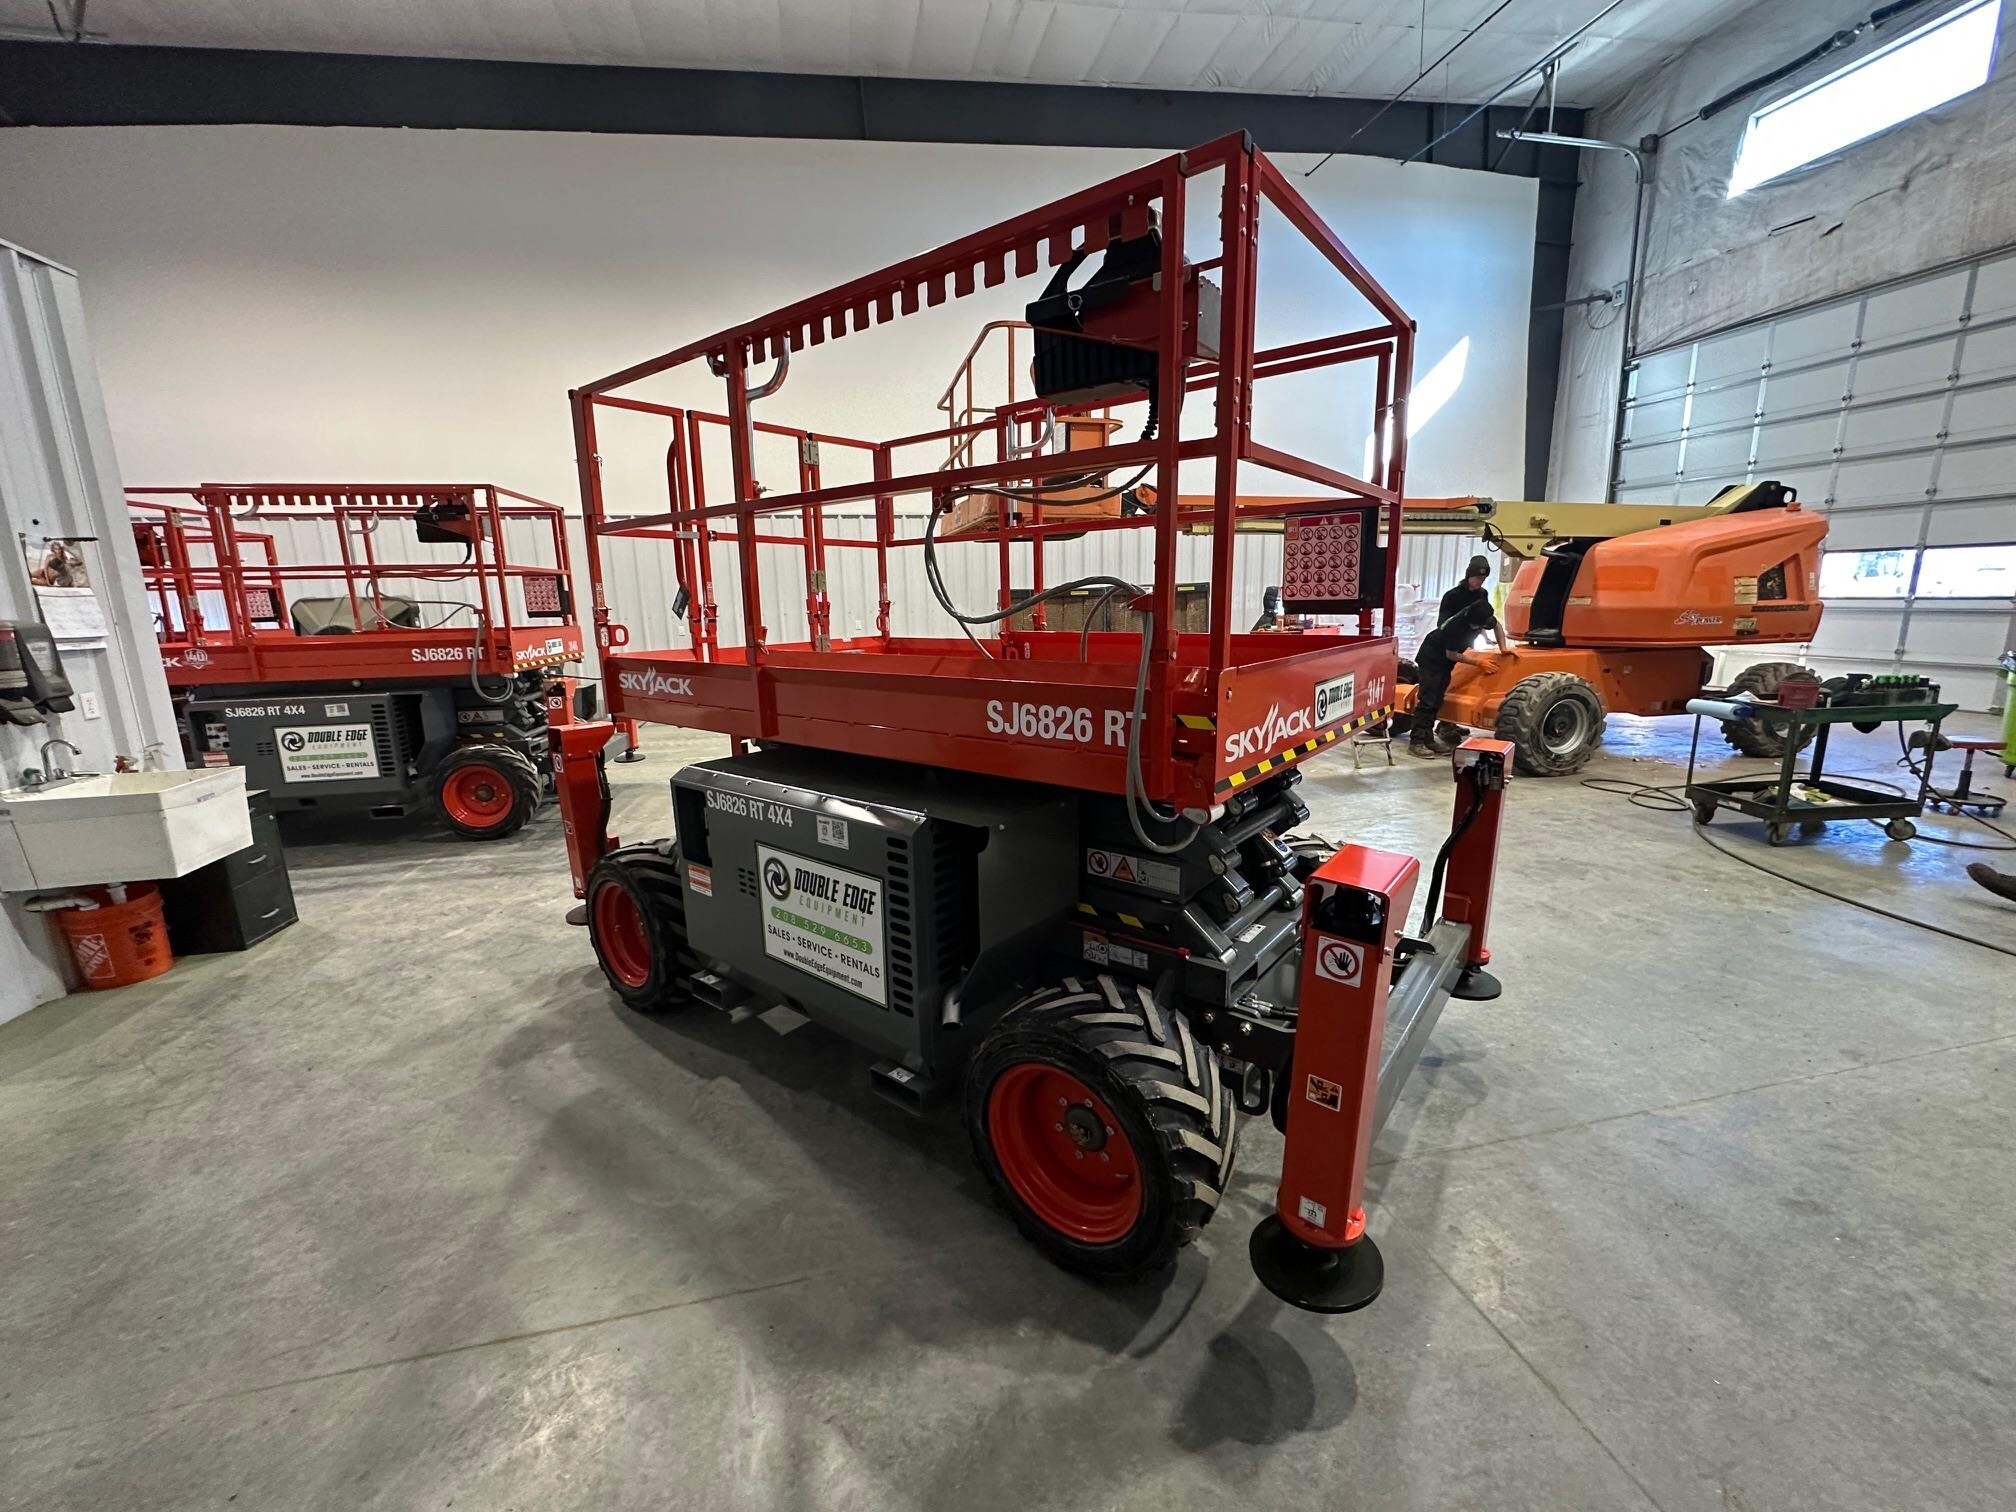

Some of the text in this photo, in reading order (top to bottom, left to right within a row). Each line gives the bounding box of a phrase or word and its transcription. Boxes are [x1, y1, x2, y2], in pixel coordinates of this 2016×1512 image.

[411, 648, 463, 661] SJ6826
[618, 666, 694, 696] SKYJACK
[1366, 676, 1386, 706] 3147
[225, 705, 306, 718] SJ6826 RT 4X4
[986, 699, 1147, 747] SJ6826 R
[307, 729, 368, 743] DOUBLE EDGE
[1225, 701, 1312, 763] SKYJACK
[287, 764, 307, 772] SALES
[706, 789, 793, 828] SJ6826 RT 4X4
[794, 867, 877, 916] DOUBLE EDGE
[800, 894, 866, 928] EQUIPMENT
[767, 923, 880, 979] SALES SERVICE RENTALS
[834, 931, 868, 953] 6653
[783, 949, 863, 989] www.DoubleEdgeEquipment.com
